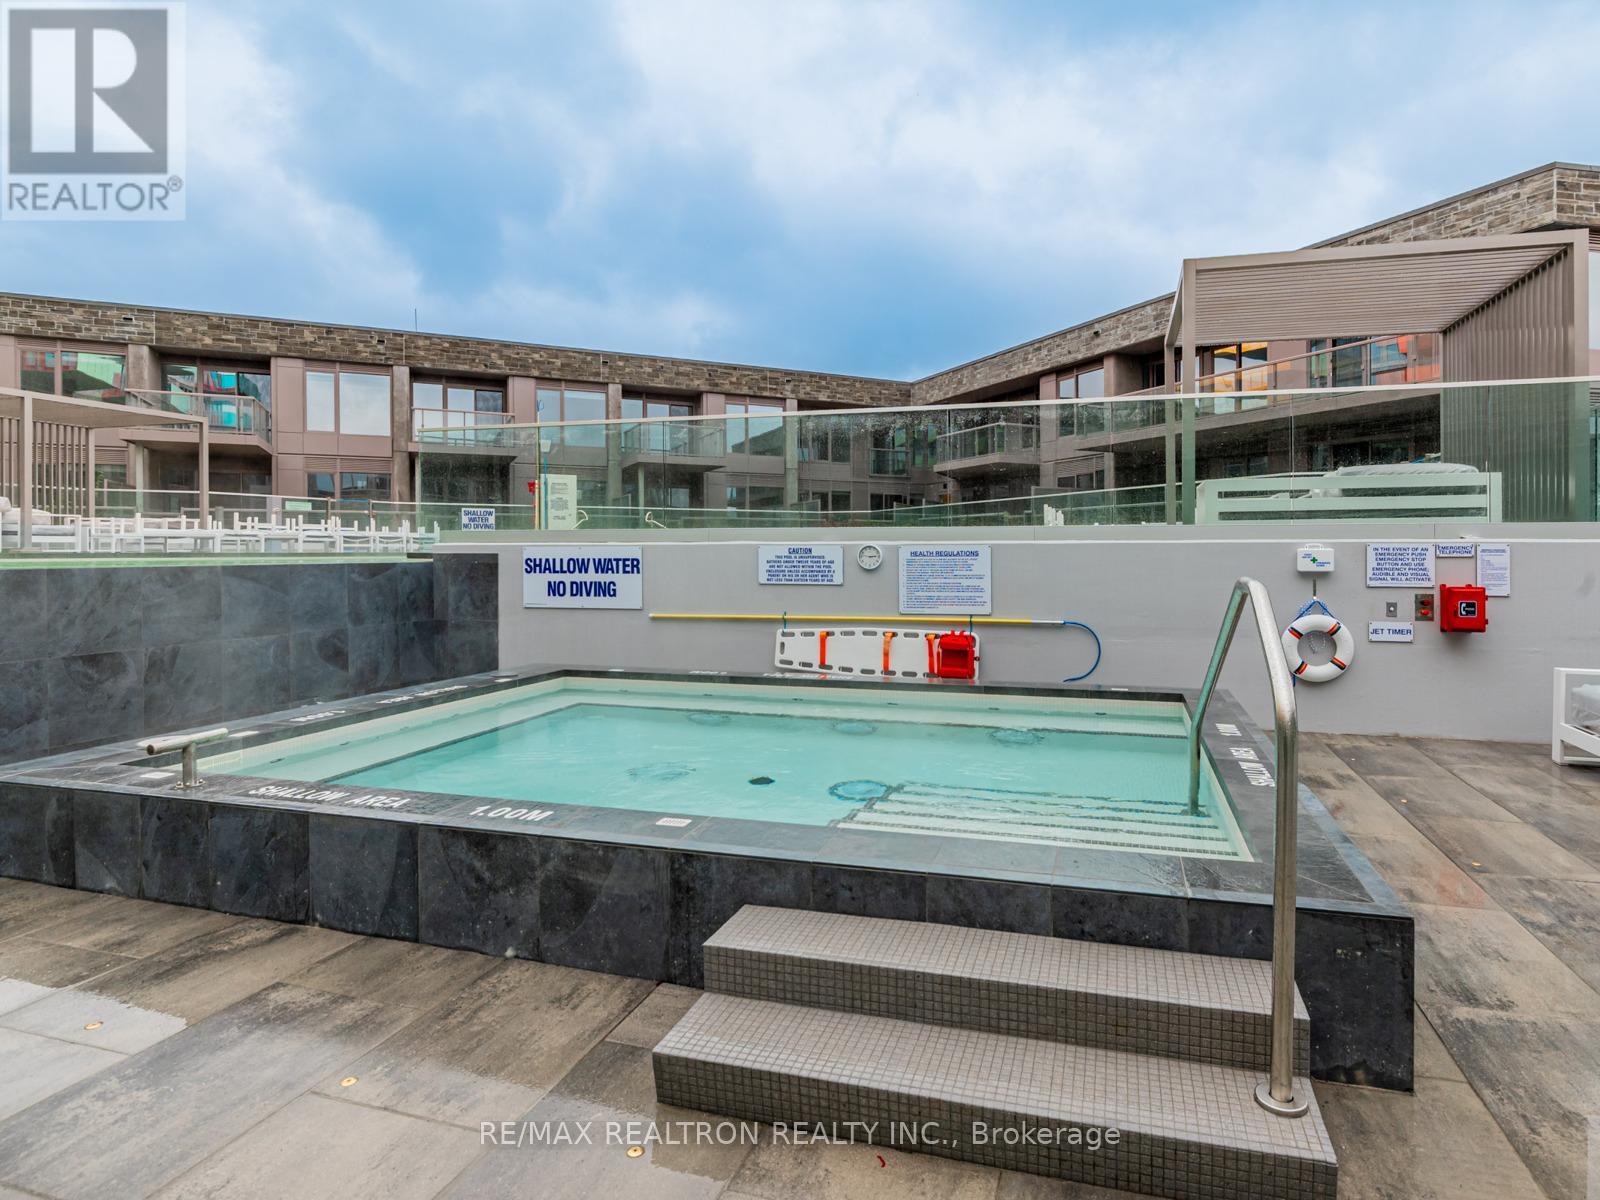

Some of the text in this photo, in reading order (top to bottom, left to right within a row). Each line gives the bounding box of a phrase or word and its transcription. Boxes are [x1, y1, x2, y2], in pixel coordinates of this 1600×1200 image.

[524, 558, 640, 574] SHALLOW WATER
[547, 580, 616, 598] NO DIVING
[248, 785, 412, 808] SHALLOW AREA
[468, 805, 555, 822] 1.00M
